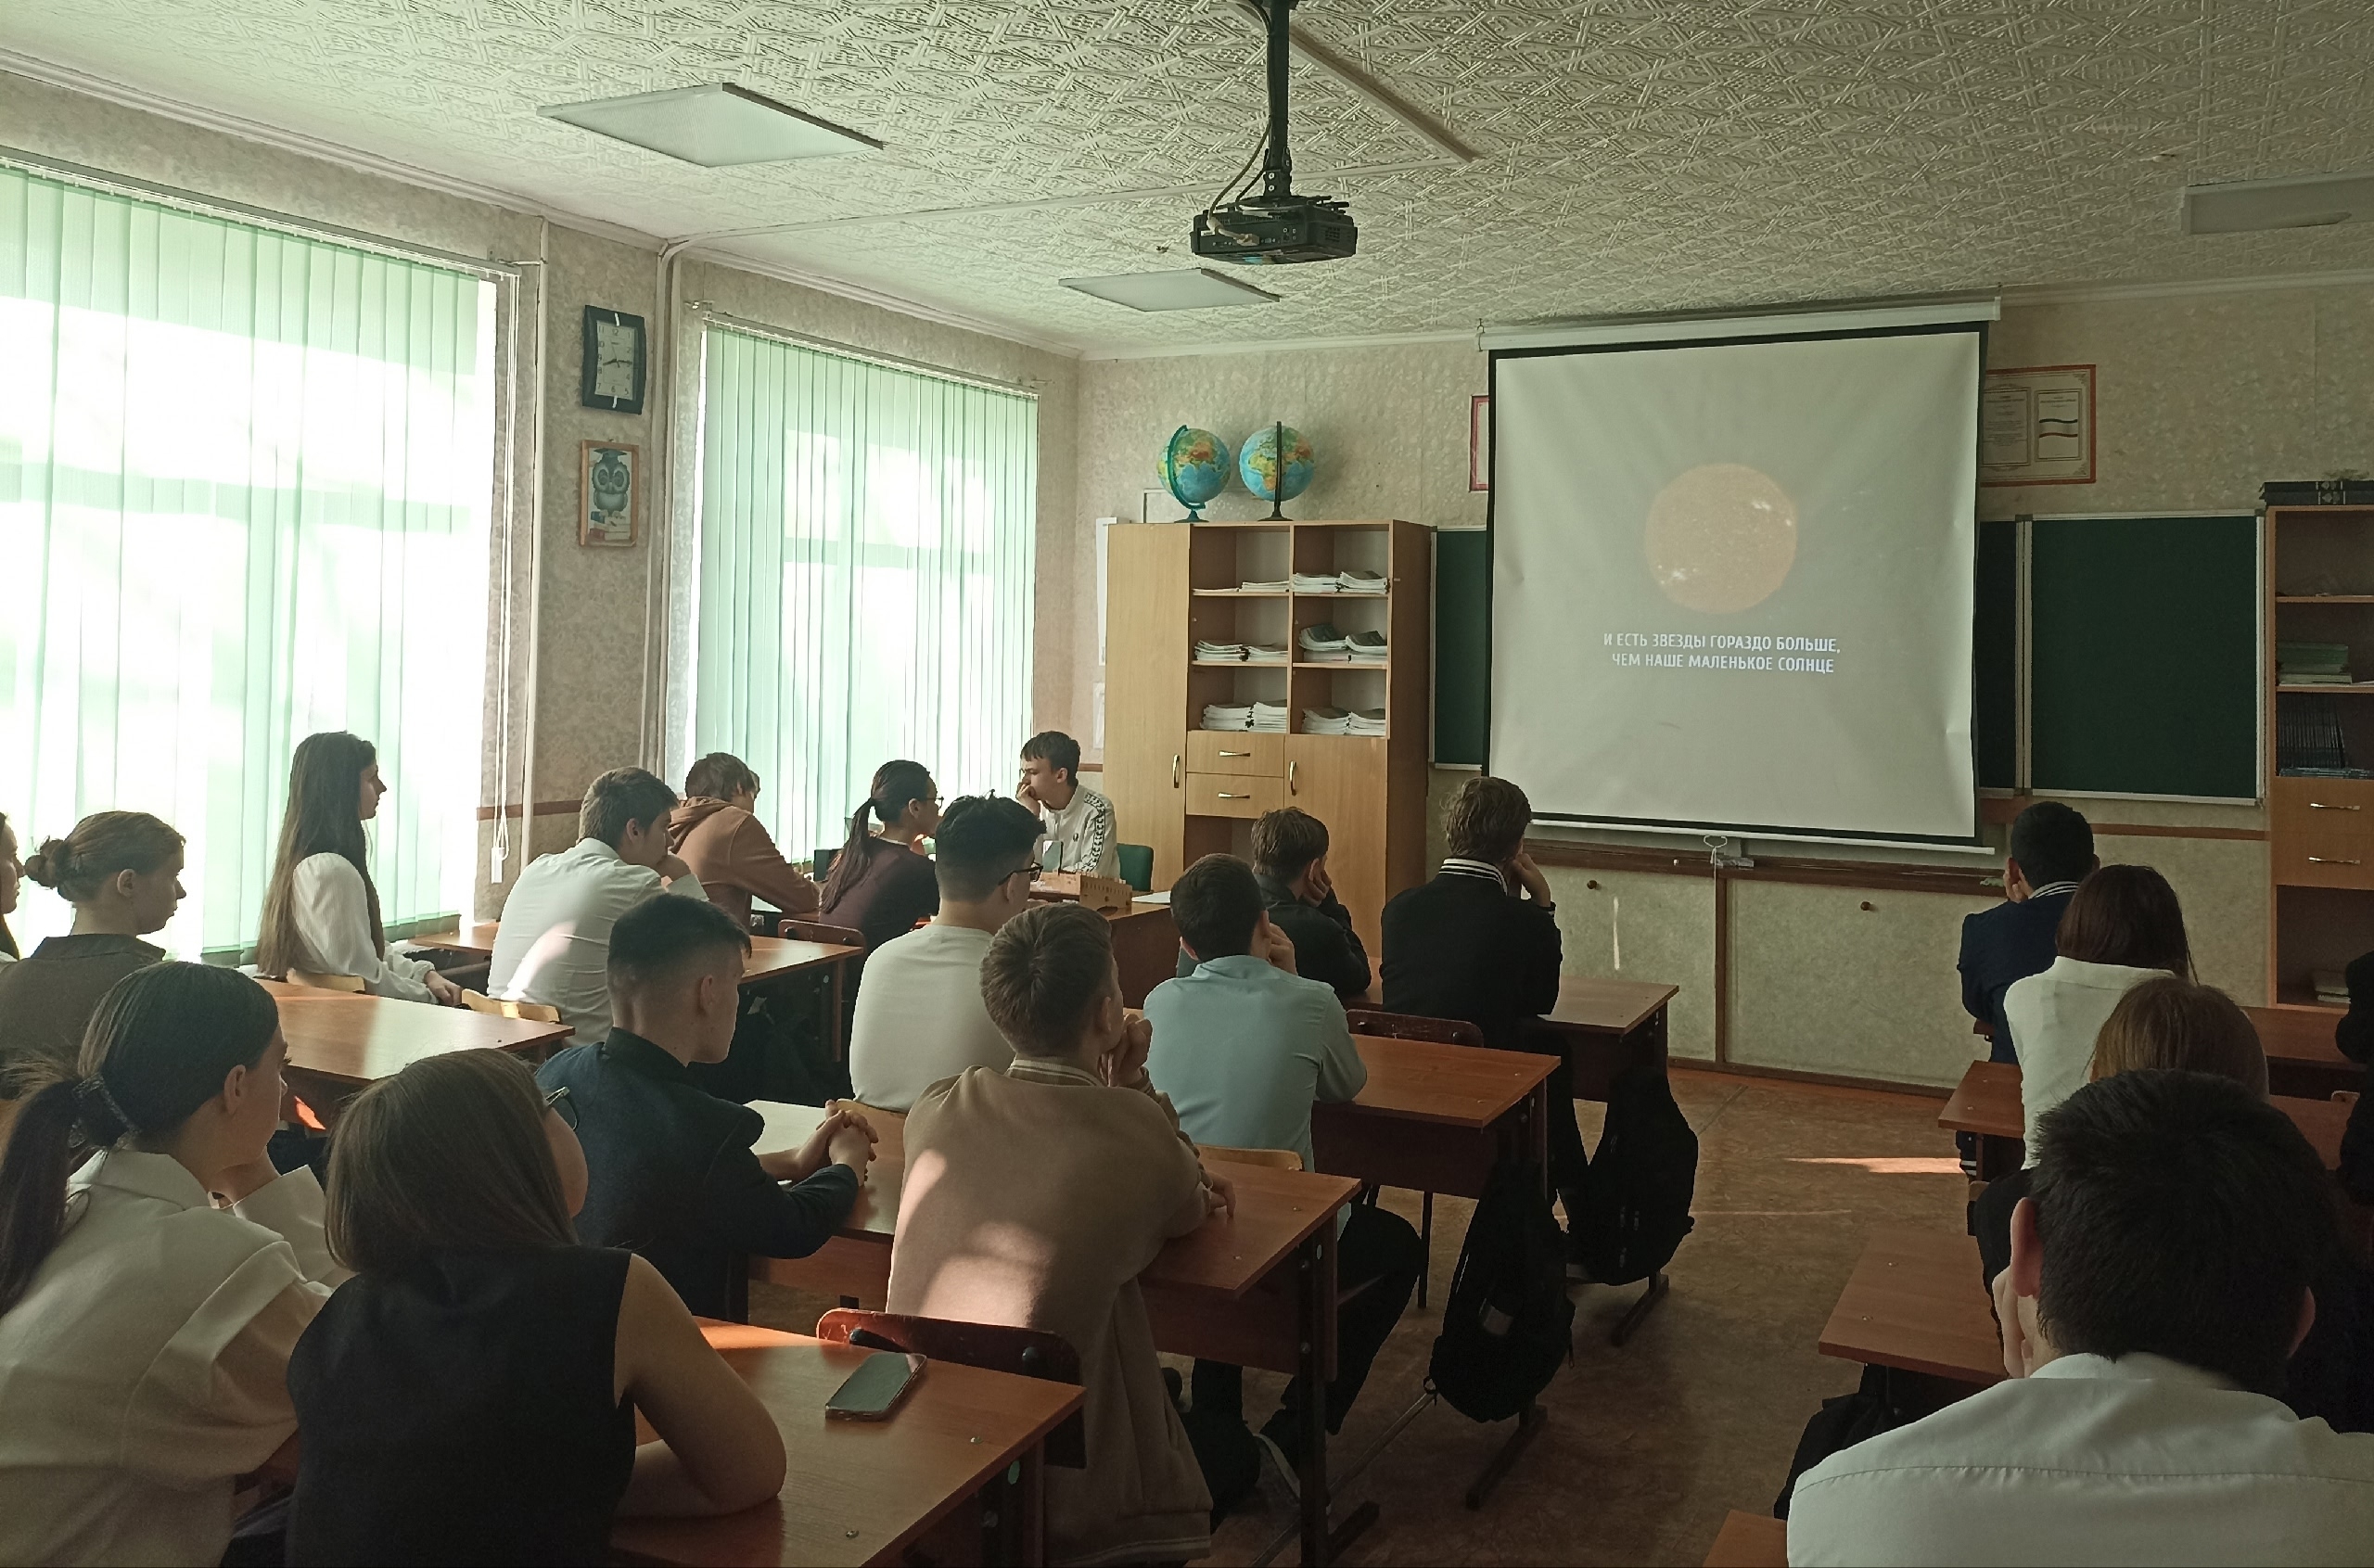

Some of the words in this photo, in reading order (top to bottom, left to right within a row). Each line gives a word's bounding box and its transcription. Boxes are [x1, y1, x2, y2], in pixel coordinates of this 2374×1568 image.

[1603, 632, 1613, 646] И
[1616, 632, 1648, 647] ЕСТЬ
[1652, 633, 1706, 650] ЗВЕЗДЫ
[1710, 635, 1772, 652] ГОРАЗДО
[1776, 636, 1841, 654] БОЛЬШЕ,
[1612, 653, 1640, 667] ЧЕМ
[1645, 654, 1684, 668] НАШЕ
[1688, 655, 1773, 670] МАЛЕНЬКОЕ
[1778, 657, 1834, 674] СОЛНЦЕ
